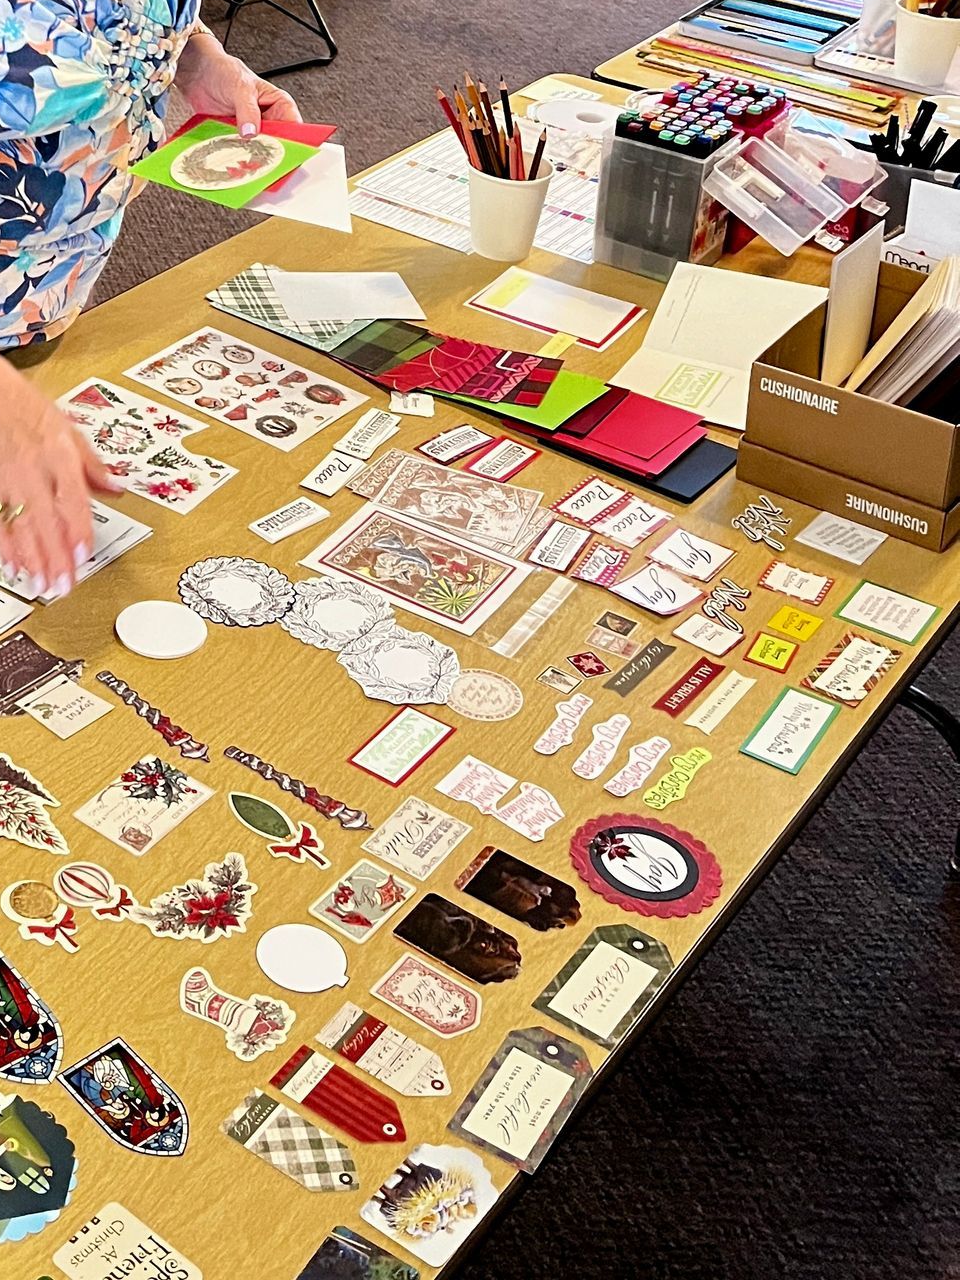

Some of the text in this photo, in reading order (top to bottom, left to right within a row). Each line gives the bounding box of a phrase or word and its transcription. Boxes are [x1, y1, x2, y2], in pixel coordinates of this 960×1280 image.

[760, 377, 839, 415] CUSHIONAIRE
[357, 414, 390, 444] CHRISTMAS
[430, 430, 478, 457] CHRISTMAS
[313, 456, 352, 485] Peace
[481, 446, 522, 477] CHRISTMAS
[571, 484, 614, 511] Peace
[845, 493, 928, 535] CUSHIONAIRE
[257, 502, 311, 533] CHRISTMAS
[612, 506, 656, 532] Peace
[732, 495, 784, 541] Noel
[544, 527, 577, 565] CHRISTMAS
[581, 548, 622, 577] Peace
[668, 532, 713, 566] Joy
[632, 567, 677, 606] Joy
[703, 578, 751, 634] Noel
[614, 665, 642, 687] season
[637, 654, 653, 672] the
[825, 644, 875, 691] Merry Christmas
[665, 664, 713, 710] ALL IS BRIGHT
[57, 696, 85, 714] wishes
[66, 700, 94, 720] joyful
[536, 694, 592, 752] Merry Christmas
[767, 701, 814, 753] Merry Christmas
[575, 716, 628, 775] Merry Christmas
[450, 764, 493, 799] Christmas
[607, 738, 670, 794] Merry Christmas
[644, 749, 707, 807] Merry Christmas
[474, 776, 509, 808] Merry
[502, 786, 550, 821] Christmas
[522, 802, 563, 833] Merry
[384, 820, 426, 857] Ride
[623, 833, 679, 892] Joy
[409, 978, 431, 1004] Halls
[572, 956, 630, 1018] Christmas
[436, 995, 452, 1018] Deck
[340, 1025, 370, 1055] holidays
[483, 1065, 522, 1121] time of the year
[496, 1064, 543, 1145] wonderful
[235, 1104, 263, 1137] wishes
[528, 1098, 551, 1127] the most
[70, 1220, 125, 1268] Christmas
[101, 1245, 118, 1263] At
